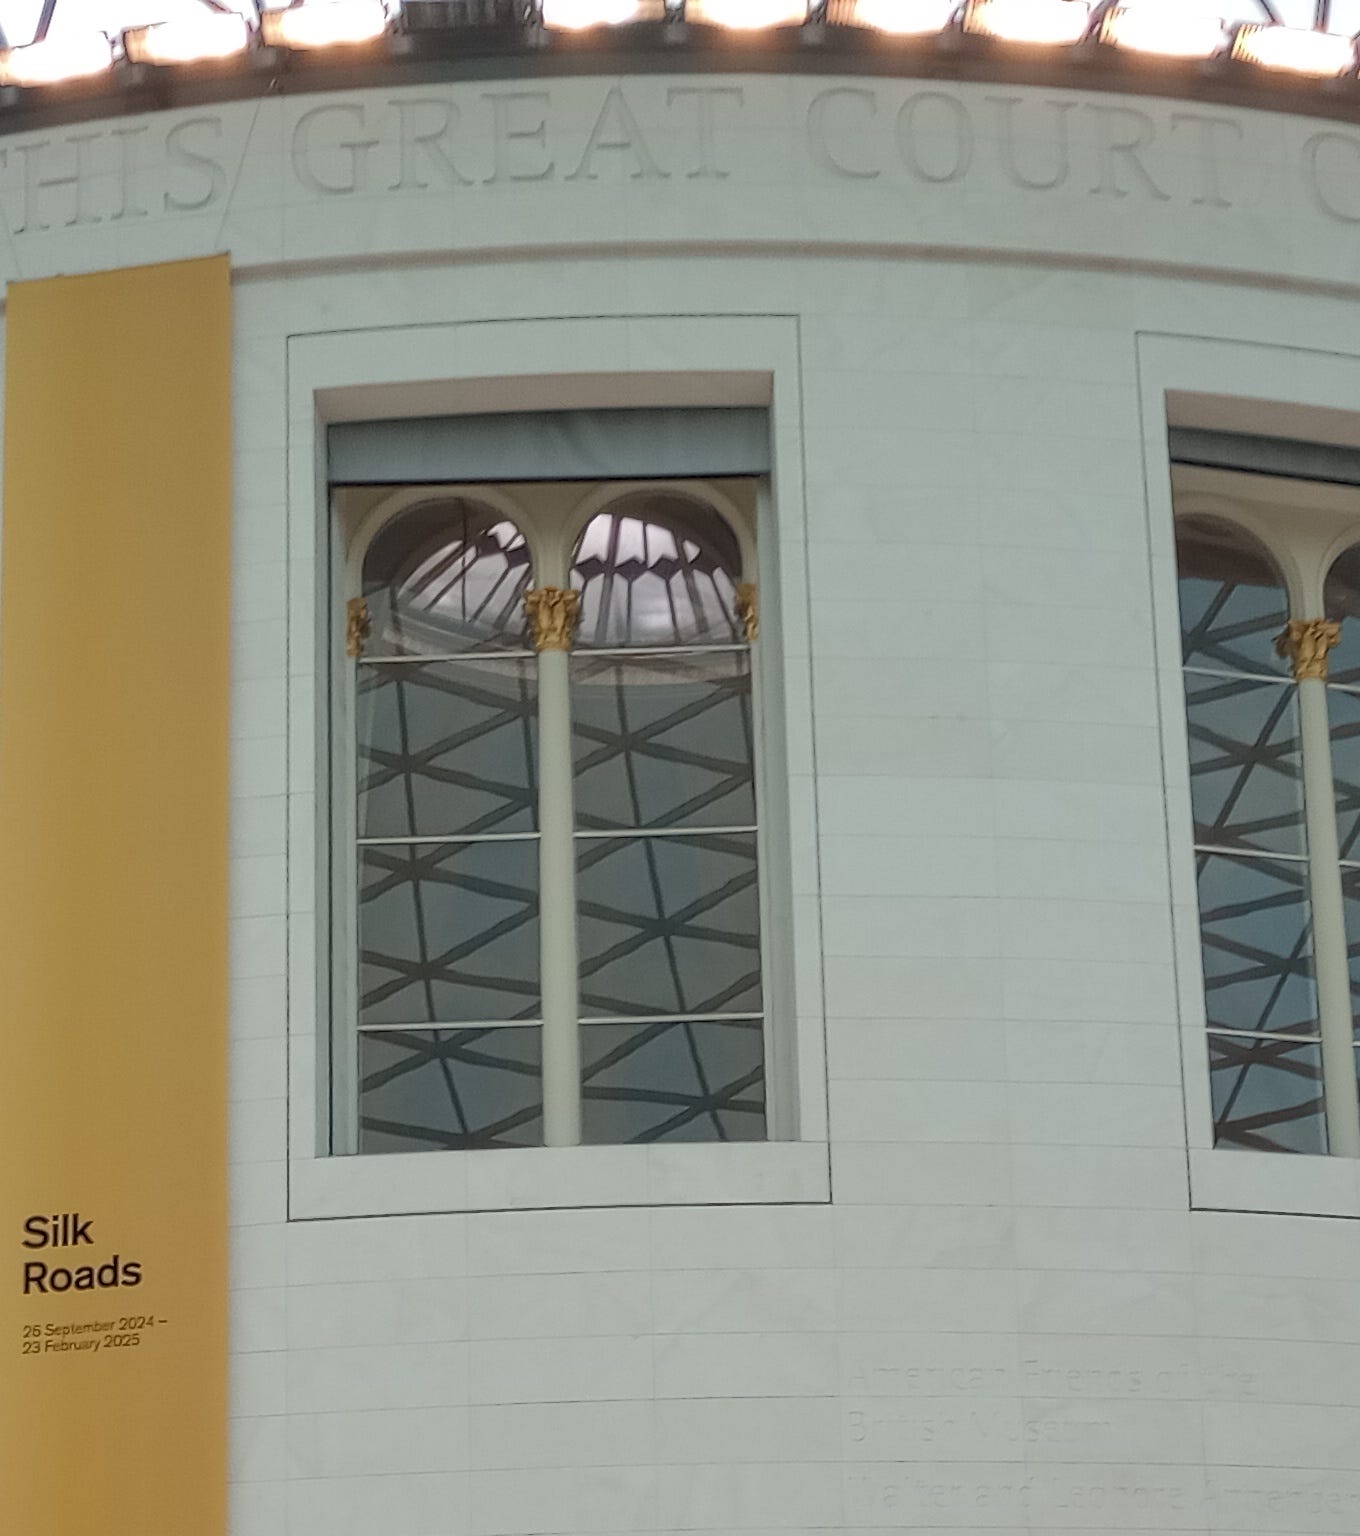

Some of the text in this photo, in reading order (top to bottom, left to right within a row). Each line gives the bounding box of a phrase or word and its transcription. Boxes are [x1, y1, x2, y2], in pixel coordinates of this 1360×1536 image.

[291, 84, 743, 196] GREAT
[805, 86, 1240, 208] COURT
[22, 1213, 94, 1249] Silk
[23, 1254, 142, 1294] Roads
[22, 1325, 41, 1338] 26
[44, 1318, 115, 1338] September
[118, 1315, 154, 1331] 2024
[22, 1333, 140, 1354] 23 February 2025
